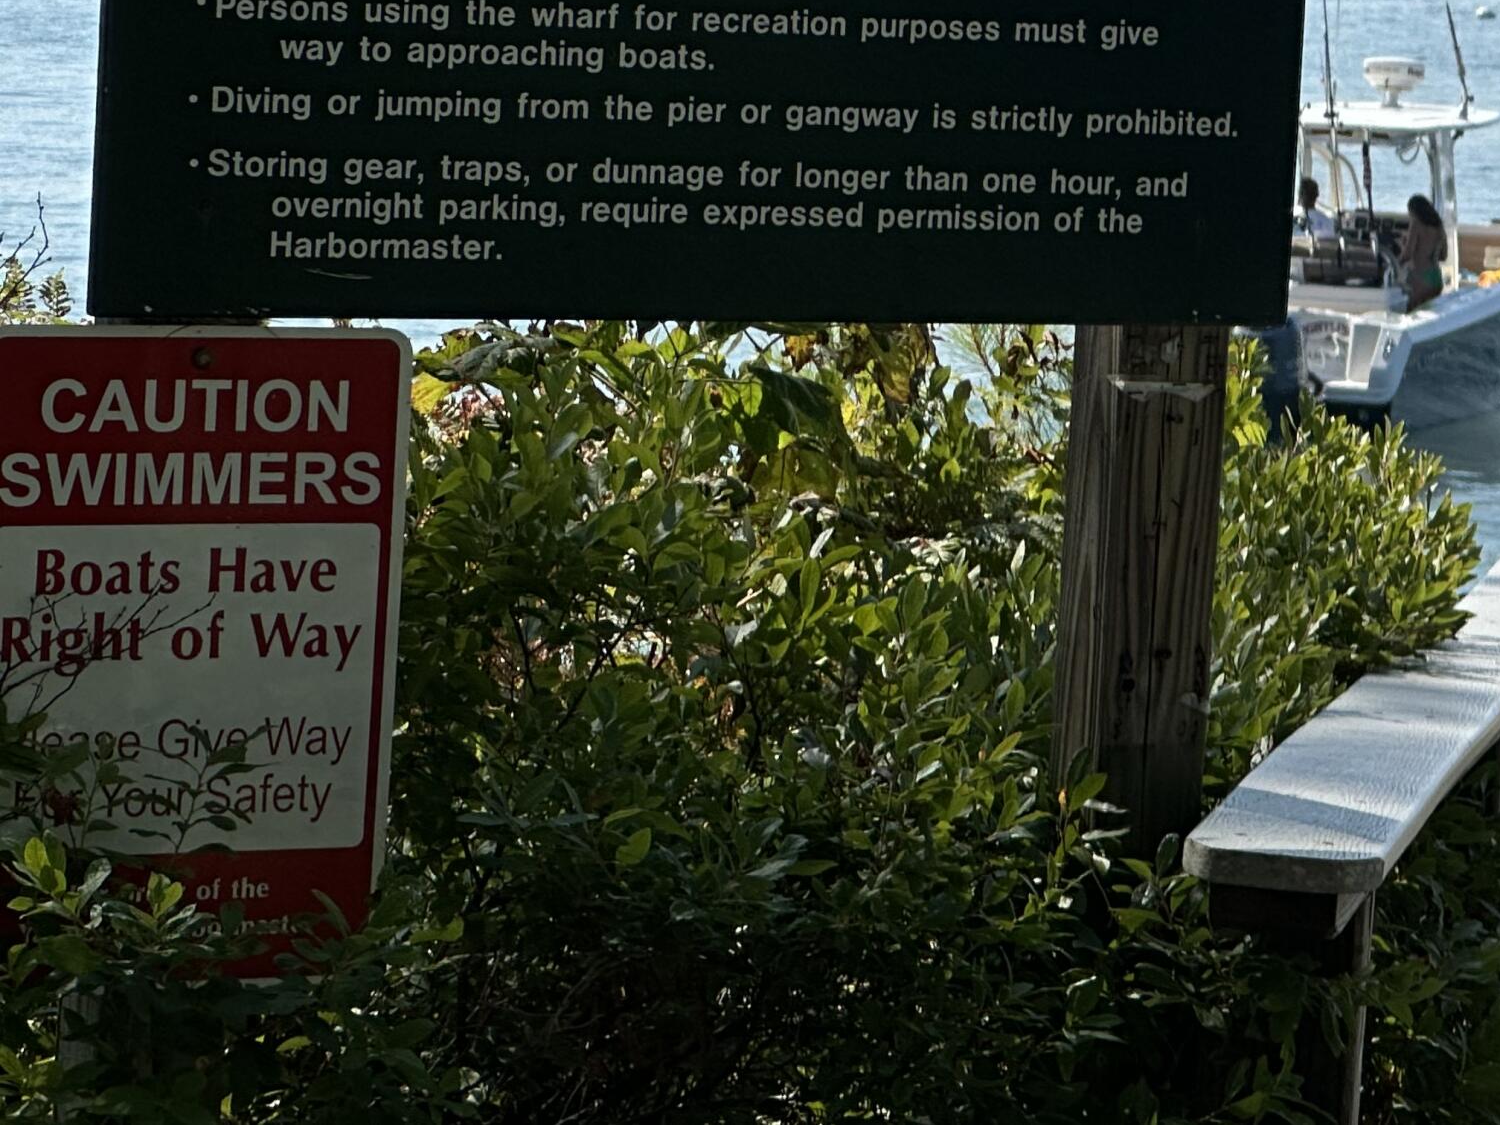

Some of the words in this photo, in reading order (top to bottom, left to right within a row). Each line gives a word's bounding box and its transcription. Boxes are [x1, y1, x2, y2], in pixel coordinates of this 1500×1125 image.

[531, 1, 620, 30] wharf
[634, 3, 678, 32] for
[691, 8, 847, 37] recreation
[860, 17, 1001, 44] purposes
[1014, 18, 1087, 44] must
[1100, 18, 1159, 51] give
[279, 39, 344, 67] way
[359, 35, 392, 63] to
[407, 39, 604, 74] approaching
[618, 41, 715, 71] boats.
[211, 85, 312, 121] Diving
[327, 94, 361, 115] or
[374, 88, 502, 125] jumping
[517, 91, 589, 120] from
[604, 93, 654, 122] the
[667, 95, 727, 128] pier
[740, 103, 772, 124] or
[785, 104, 920, 134] gangway
[932, 102, 957, 130] is
[970, 104, 1073, 138] strictly
[1085, 108, 1238, 139] prohibited.
[207, 148, 328, 185] Storing
[343, 158, 424, 186] gear,
[440, 154, 530, 188] traps,
[545, 162, 579, 183] or
[592, 156, 724, 192] dunnage
[738, 160, 782, 188] for
[795, 161, 891, 196] longer
[904, 164, 969, 192] than
[982, 172, 1037, 194] one
[1050, 167, 1122, 201] hour,
[1135, 171, 1188, 198] and
[271, 191, 424, 226] overnight
[438, 193, 566, 228] parking,
[580, 196, 689, 229] require
[703, 201, 864, 231] expressed
[877, 203, 1040, 234] permission
[1053, 205, 1085, 233] of
[1097, 206, 1143, 234] the
[269, 230, 503, 261] Harbormaster.
[41, 378, 350, 434] CAUTION
[0, 451, 381, 507] SWIMMERS
[35, 549, 180, 596] Boats
[207, 546, 337, 593] Have
[0, 612, 143, 676] Right
[170, 609, 225, 661] of
[250, 611, 363, 673] Way
[158, 718, 249, 759] Give
[264, 716, 352, 765] Way
[101, 783, 186, 818] Your
[206, 773, 332, 823] Safety
[195, 877, 222, 901] of
[230, 876, 271, 900] the
